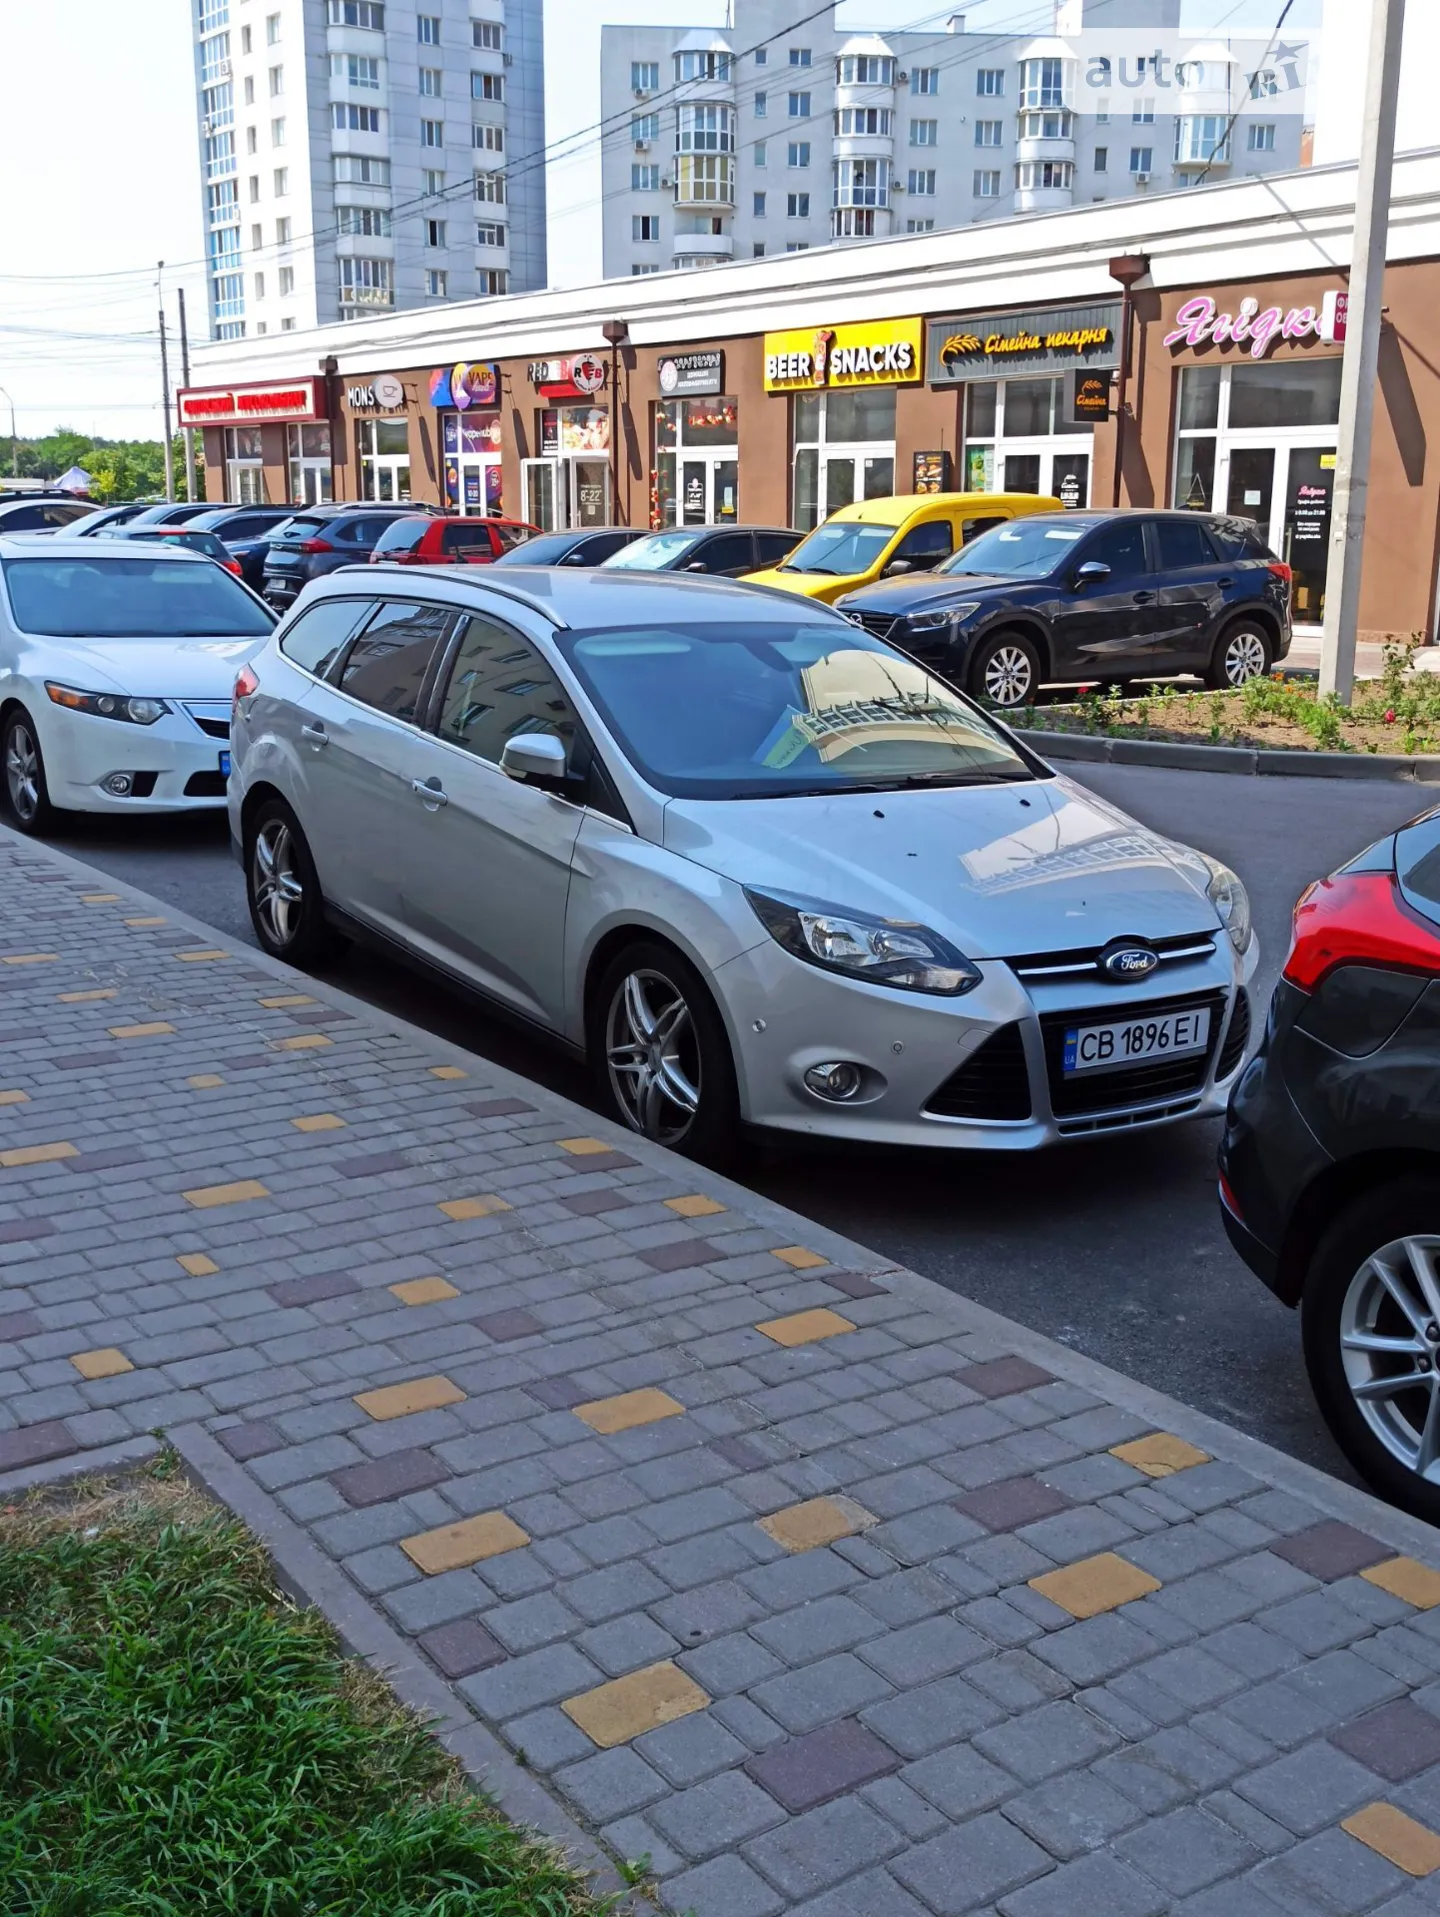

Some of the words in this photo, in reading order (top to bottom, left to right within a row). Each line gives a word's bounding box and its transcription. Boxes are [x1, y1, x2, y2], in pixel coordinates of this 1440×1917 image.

[1337, 297, 1348, 309] Ф
[984, 330, 1042, 354] Сімейна
[1045, 327, 1108, 353] пекарня
[766, 352, 811, 380] BEER
[830, 341, 912, 374] SNACKS
[468, 371, 494, 386] VAPE
[347, 385, 375, 407] MONS
[1121, 953, 1149, 970] Ford
[1080, 1030, 1115, 1061] CB
[1121, 1020, 1170, 1055] 1896
[1064, 1055, 1075, 1065] UA
